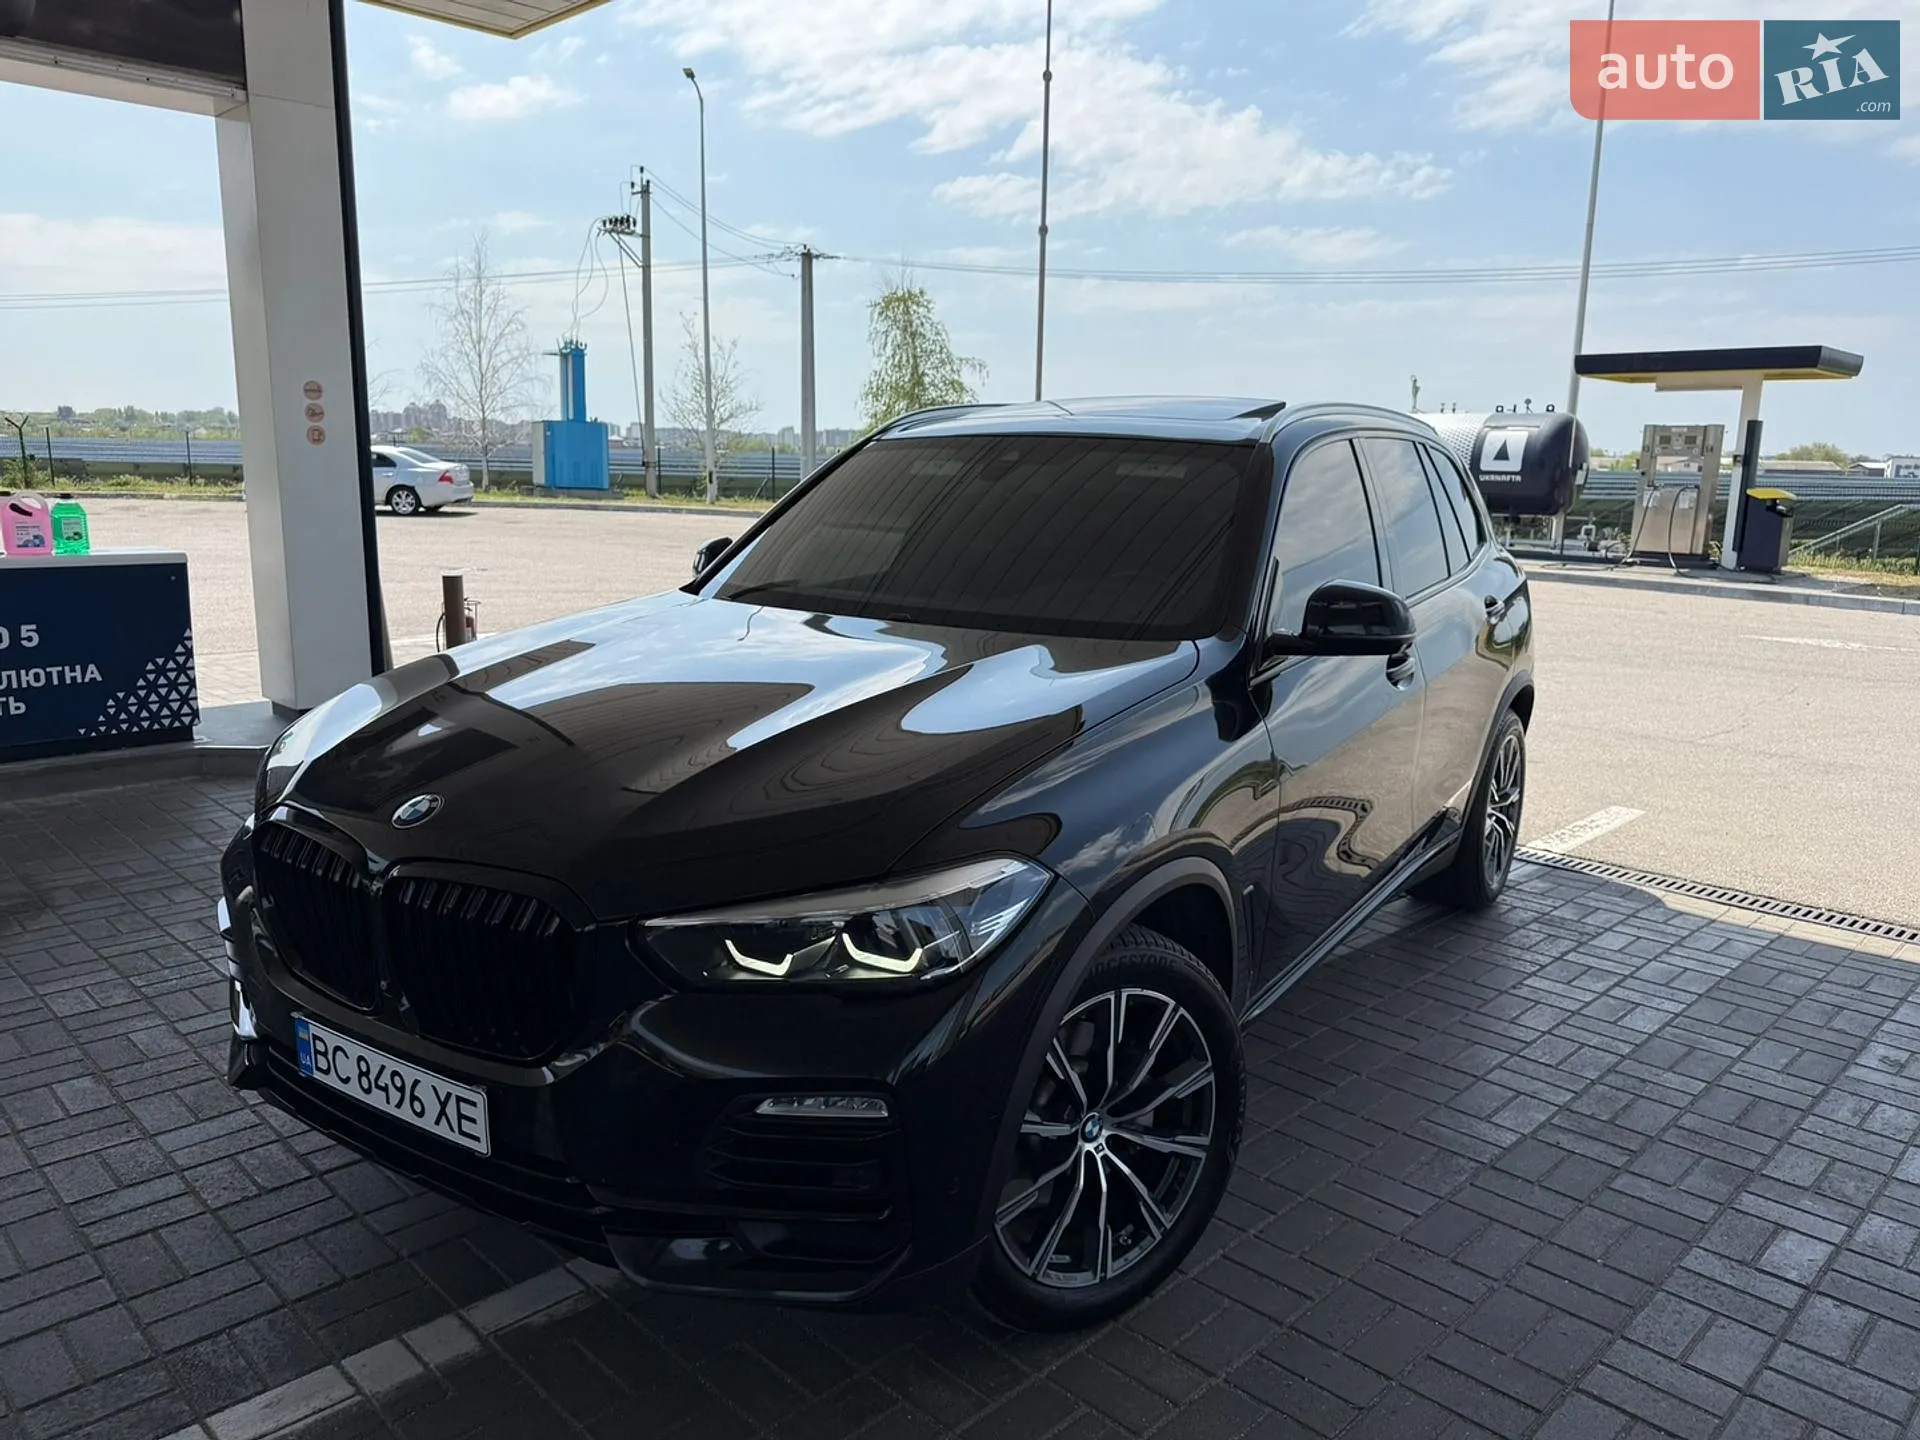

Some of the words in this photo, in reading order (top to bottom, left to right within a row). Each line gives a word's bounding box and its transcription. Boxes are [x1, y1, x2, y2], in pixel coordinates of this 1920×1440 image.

[300, 1051, 312, 1067] UA
[311, 1032, 352, 1085] BC
[356, 1054, 426, 1119] 8496
[430, 1084, 482, 1144] XE
